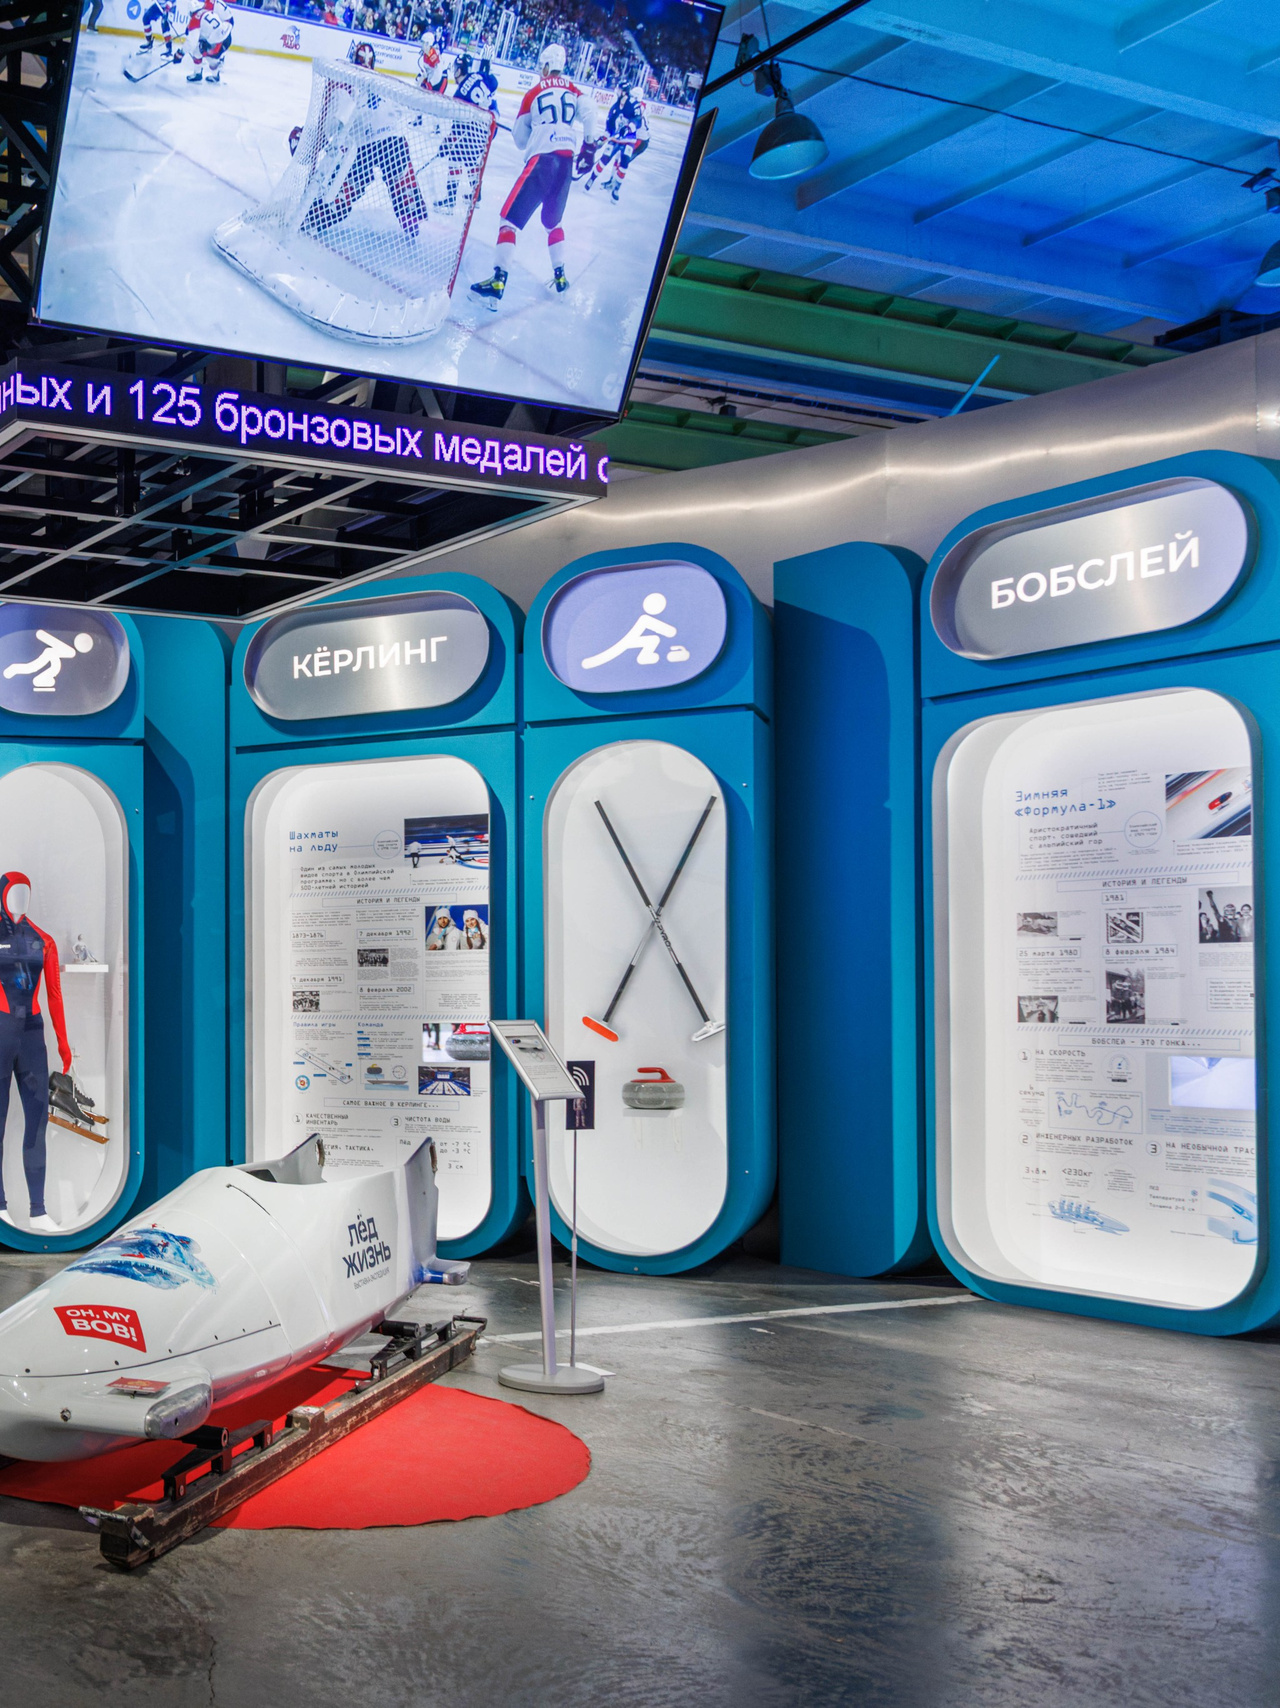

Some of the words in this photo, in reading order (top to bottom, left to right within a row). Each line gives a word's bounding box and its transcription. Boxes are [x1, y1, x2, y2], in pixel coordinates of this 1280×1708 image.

[540, 78, 570, 89] RYKOV
[537, 91, 576, 126] 56
[86, 382, 111, 416] и
[129, 379, 202, 427] 125
[214, 392, 423, 458] бронзовых
[434, 432, 587, 481] медалей
[991, 530, 1199, 610] БОБСЛЕЙ
[293, 635, 448, 679] КЁРЛИНГ
[1015, 789, 1068, 803] Зимняя
[1029, 822, 1098, 834] Аристократичный
[289, 831, 339, 840] Шахматы
[311, 843, 338, 853] льду
[1038, 839, 1084, 849] альпийский
[1102, 878, 1140, 888] ИСТОРИЯ
[1141, 878, 1147, 886] И
[1151, 876, 1188, 886] ЛЕГЕНДЫ
[1091, 1037, 1127, 1046] БОБСЛЕЙ
[1140, 1038, 1155, 1046] ЭТО
[1049, 1049, 1086, 1057] СКОРОСТЬ
[1035, 1133, 1082, 1142] ИНЖЕНЕРНЫХ
[1086, 1136, 1134, 1146] РАЗРАБОТОК
[1150, 1143, 1157, 1154] 3
[1181, 1143, 1229, 1153] НЕОБЫЧНОЙ
[66, 1309, 100, 1319] OH,
[103, 1310, 131, 1323] MY
[70, 1319, 138, 1342] BOB!
